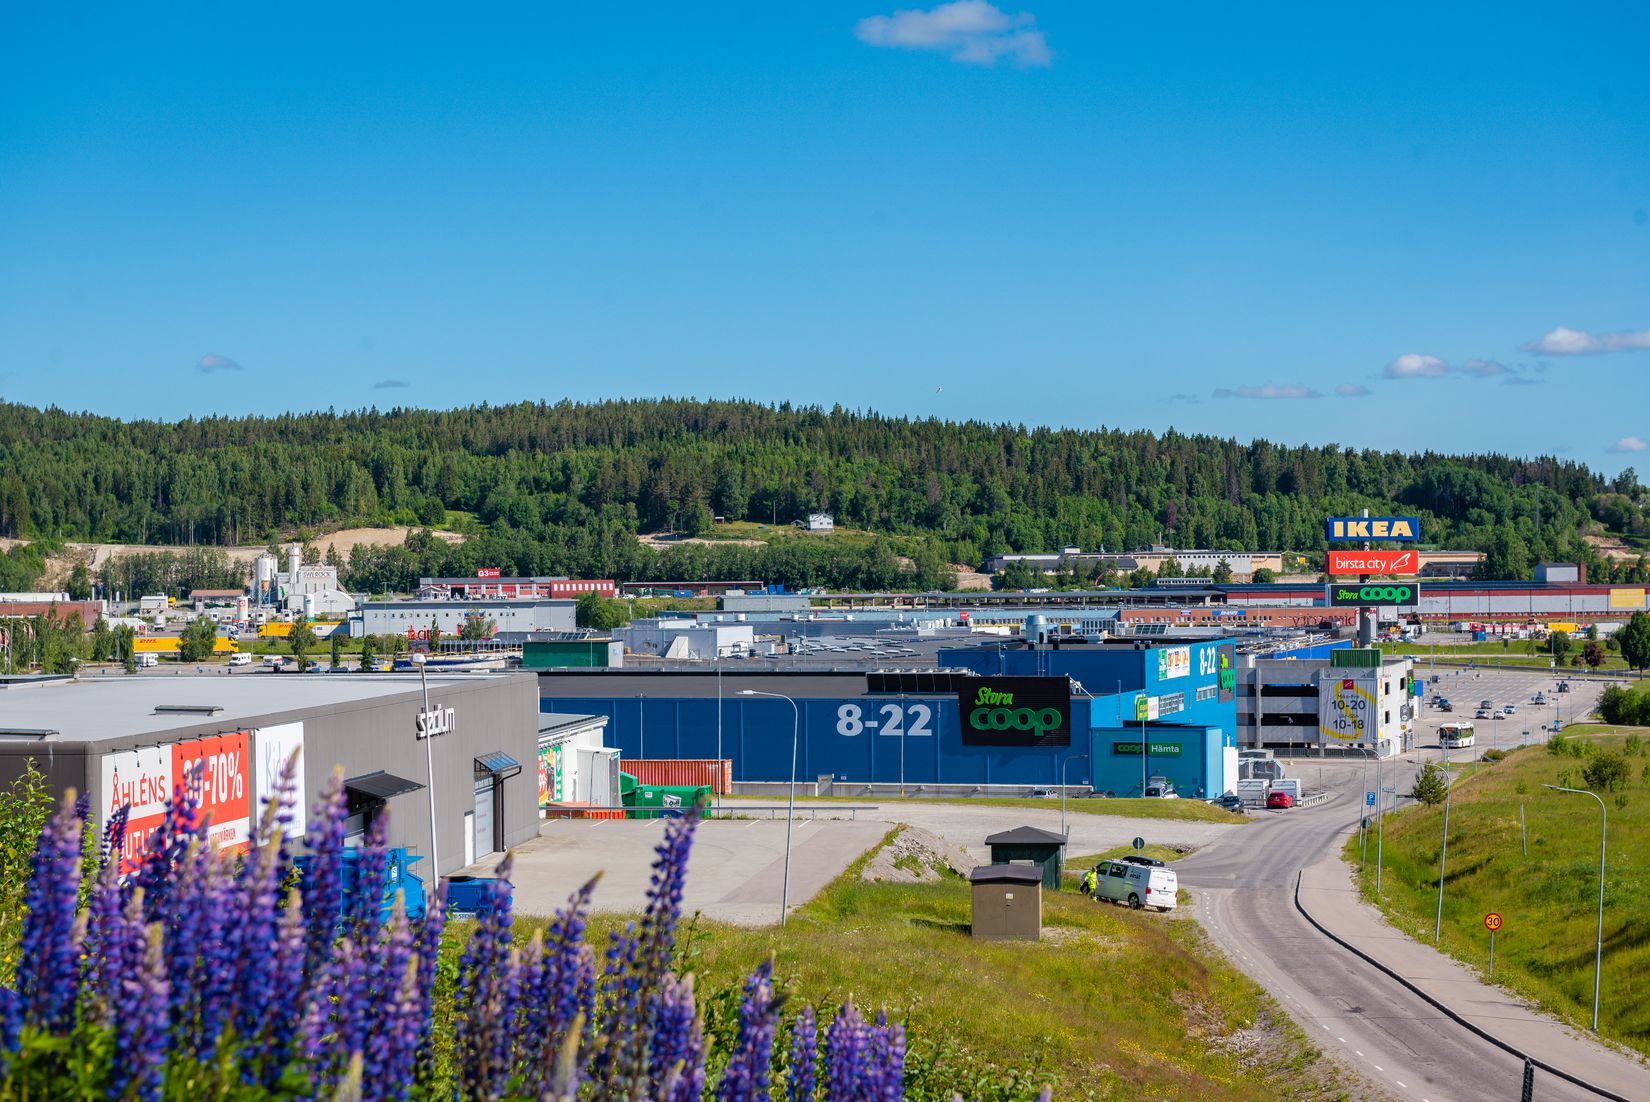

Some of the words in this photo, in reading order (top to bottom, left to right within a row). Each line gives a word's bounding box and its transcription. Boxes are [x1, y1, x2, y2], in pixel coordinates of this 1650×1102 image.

[1333, 520, 1413, 537] IKEA
[1335, 556, 1365, 569] birsta
[1366, 556, 1387, 572] city
[1336, 589, 1358, 601] Stora
[1359, 586, 1411, 604] coop
[1199, 646, 1216, 676] 8-22
[975, 686, 1013, 706] Stora
[1331, 700, 1366, 710] 10-20
[836, 703, 933, 737] 8-22
[969, 707, 1062, 737] coop
[1332, 719, 1365, 730] 10-18
[1117, 744, 1144, 754] coop
[1151, 744, 1180, 753] Hämta
[110, 772, 166, 813] ÅHLÉNS
[1487, 916, 1500, 926] 30
